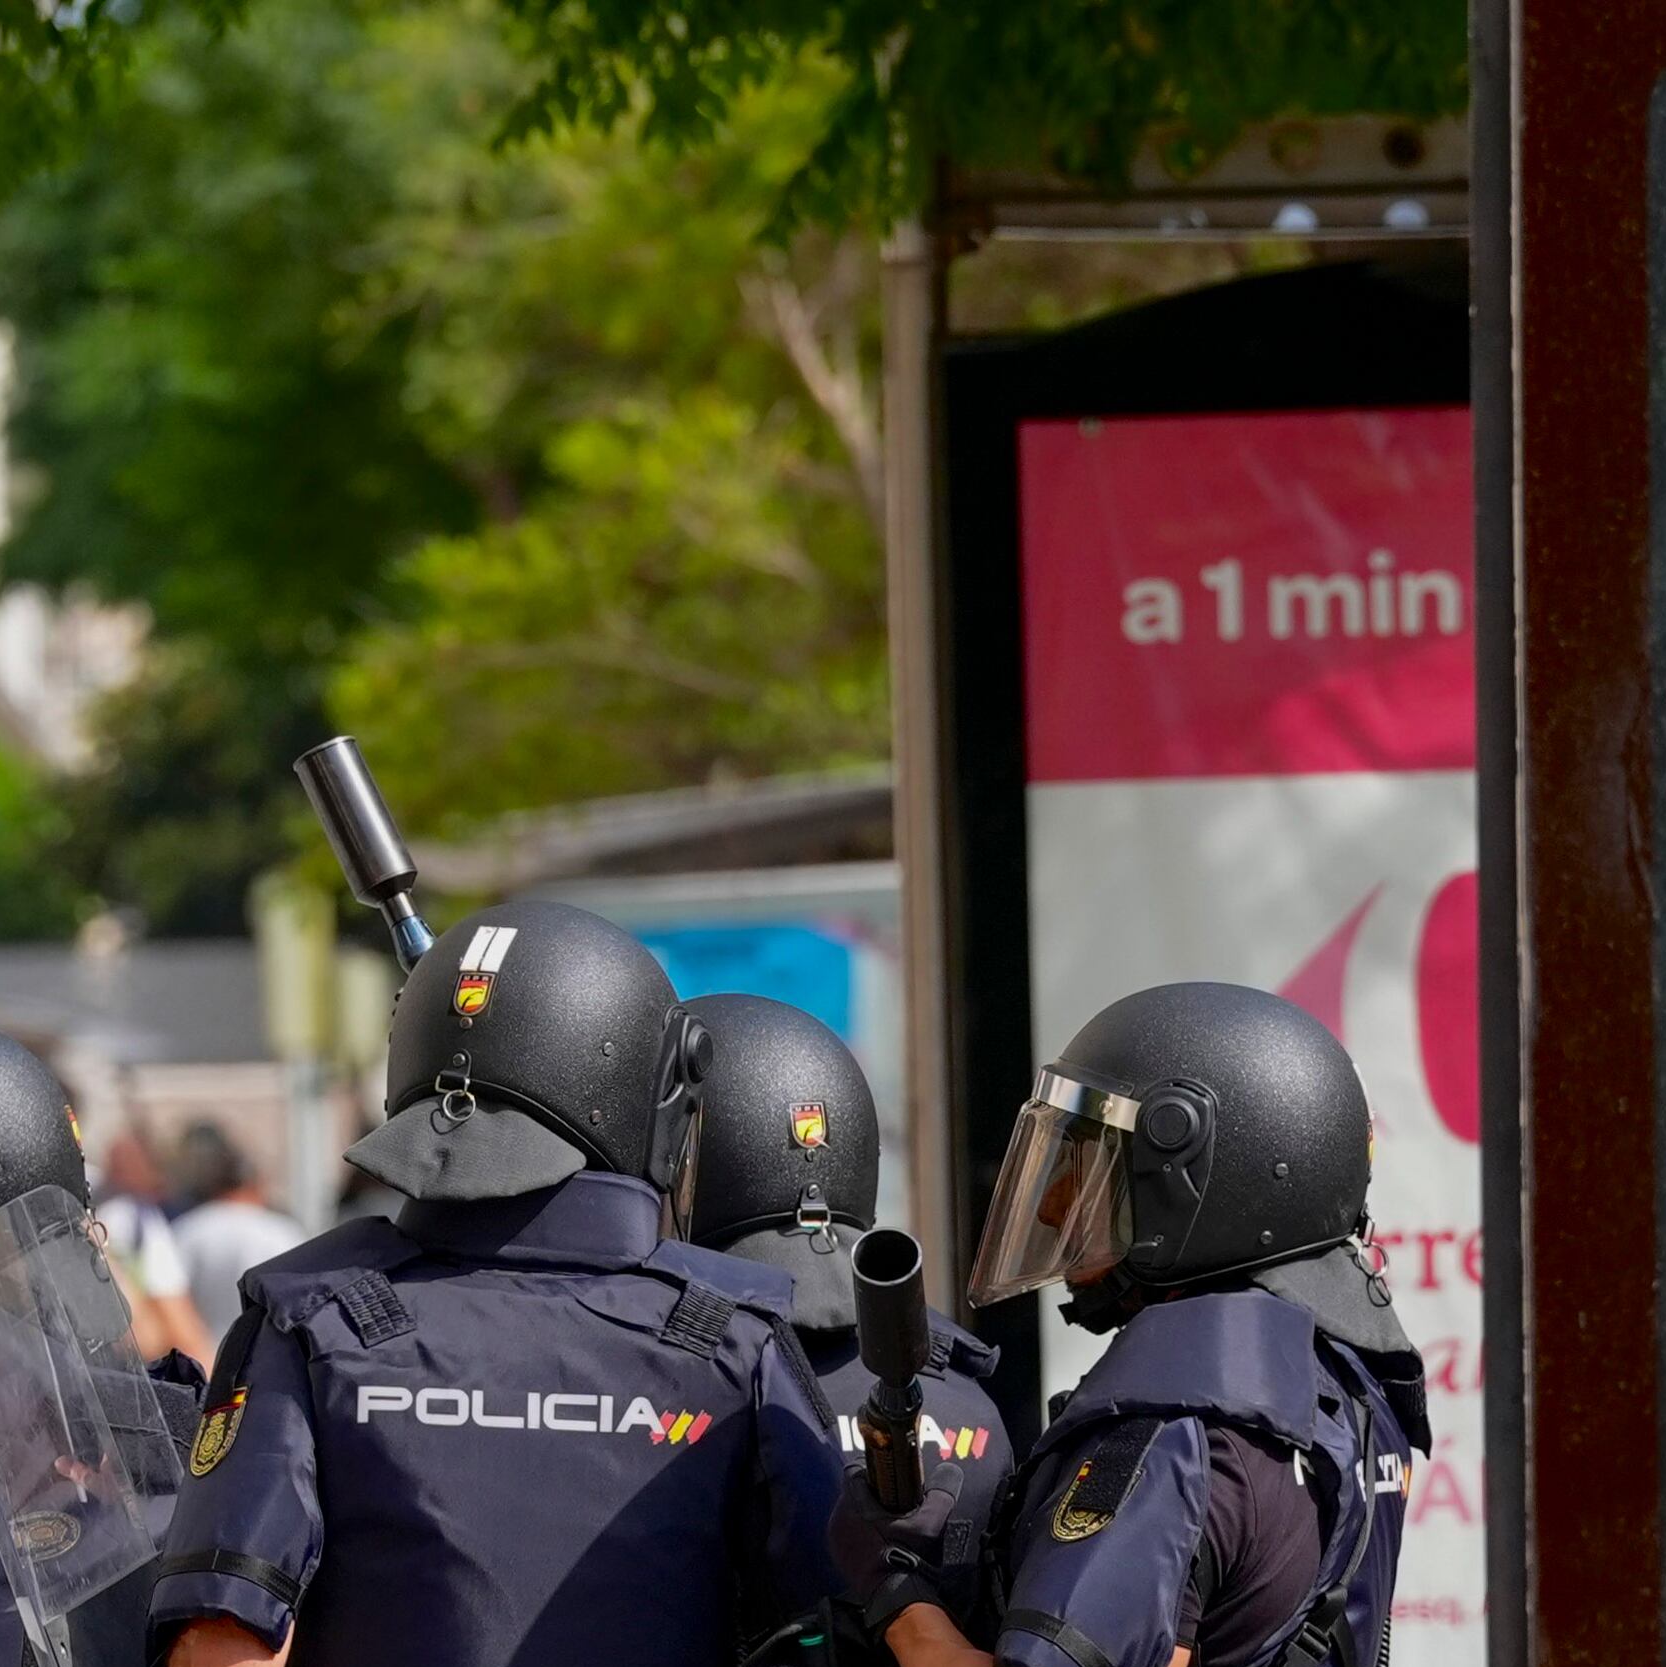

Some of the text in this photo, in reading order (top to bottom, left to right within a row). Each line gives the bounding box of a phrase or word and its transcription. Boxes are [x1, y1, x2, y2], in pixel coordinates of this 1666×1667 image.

[1120, 547, 1464, 645] a 1 min
[357, 1385, 666, 1436] POLICIA
